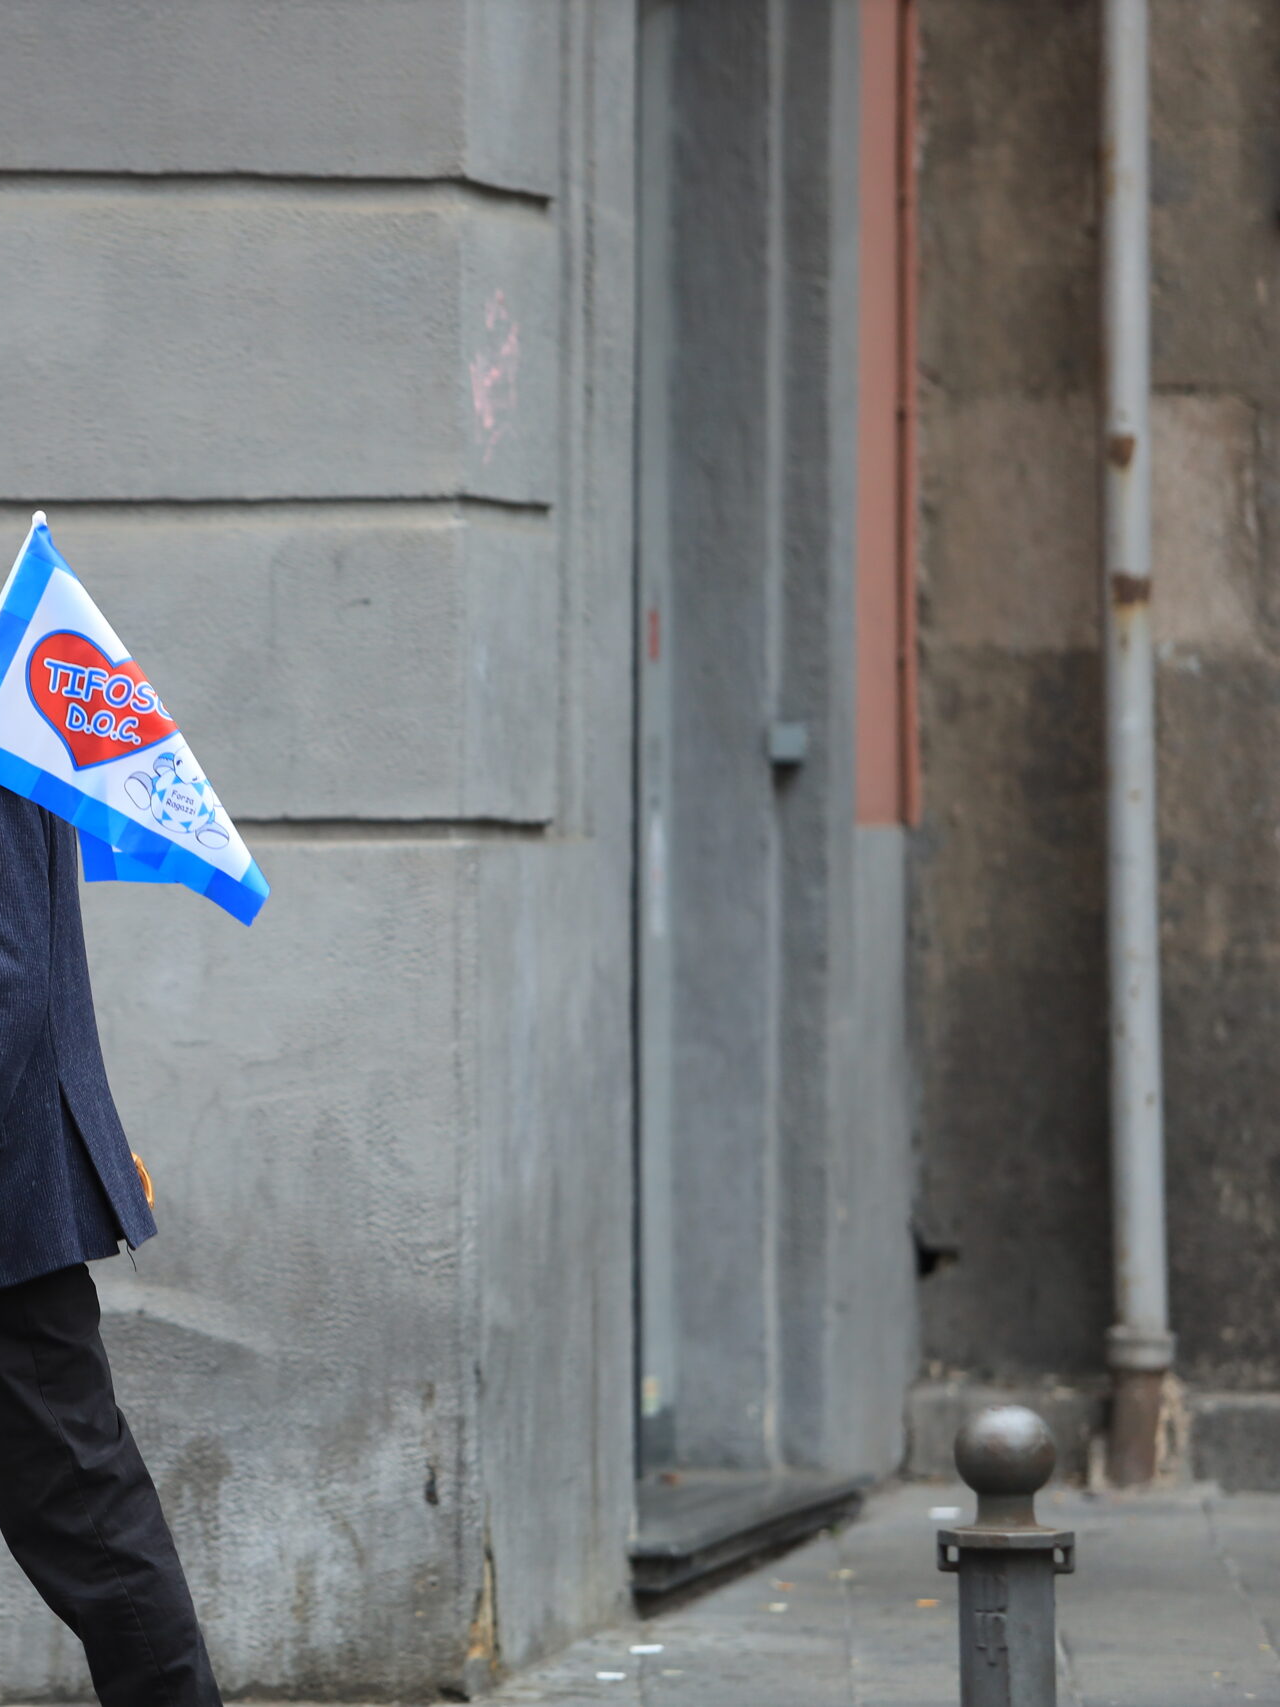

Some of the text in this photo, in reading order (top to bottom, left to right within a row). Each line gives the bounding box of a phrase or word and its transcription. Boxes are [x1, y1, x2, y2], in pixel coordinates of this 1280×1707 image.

[66, 702, 141, 744] D.O.C.
[171, 789, 194, 805] Forza
[166, 798, 196, 815] Ragazzi
